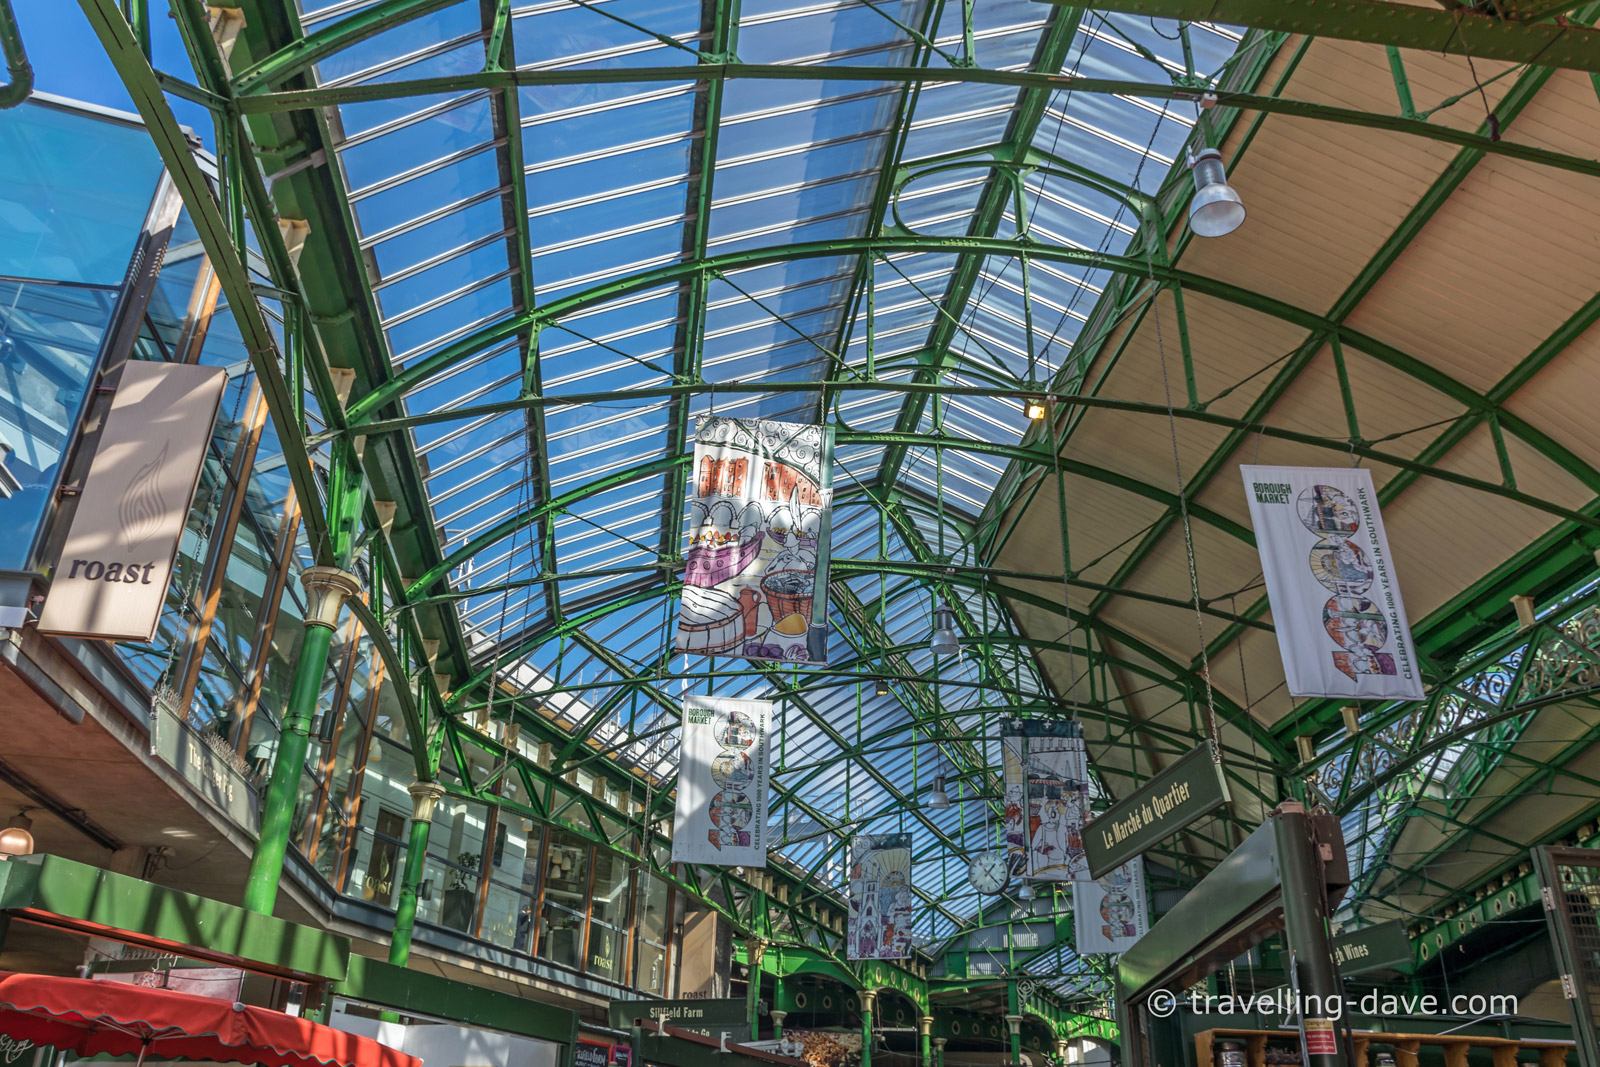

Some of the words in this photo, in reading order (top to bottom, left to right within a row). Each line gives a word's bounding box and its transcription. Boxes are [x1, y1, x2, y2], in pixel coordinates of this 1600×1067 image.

[1253, 482, 1293, 494] BOROUGH
[1256, 492, 1290, 505] MARKET
[1357, 487, 1379, 545] SOUTHWARK
[1373, 547, 1382, 557] IN
[68, 558, 155, 585] roast
[1376, 558, 1390, 590] YEARS
[1385, 591, 1395, 610] 1000
[1387, 613, 1412, 680] CELEBRATING
[688, 708, 715, 717] BOROUGH
[688, 715, 712, 725] MARKET
[758, 714, 766, 756] SOUTHWARK
[758, 757, 764, 765] IN
[188, 742, 201, 771] The
[222, 774, 234, 802] Pig
[1101, 830, 1115, 850] Le
[1112, 808, 1143, 843] Marché
[1141, 803, 1154, 825] du
[1151, 781, 1191, 820] Quartier
[362, 875, 392, 895] roast
[1343, 943, 1369, 961] Wines
[594, 955, 613, 970] roast
[682, 990, 708, 999] roast
[650, 1006, 681, 1019] Sillfield
[683, 1006, 704, 1018] Farm
